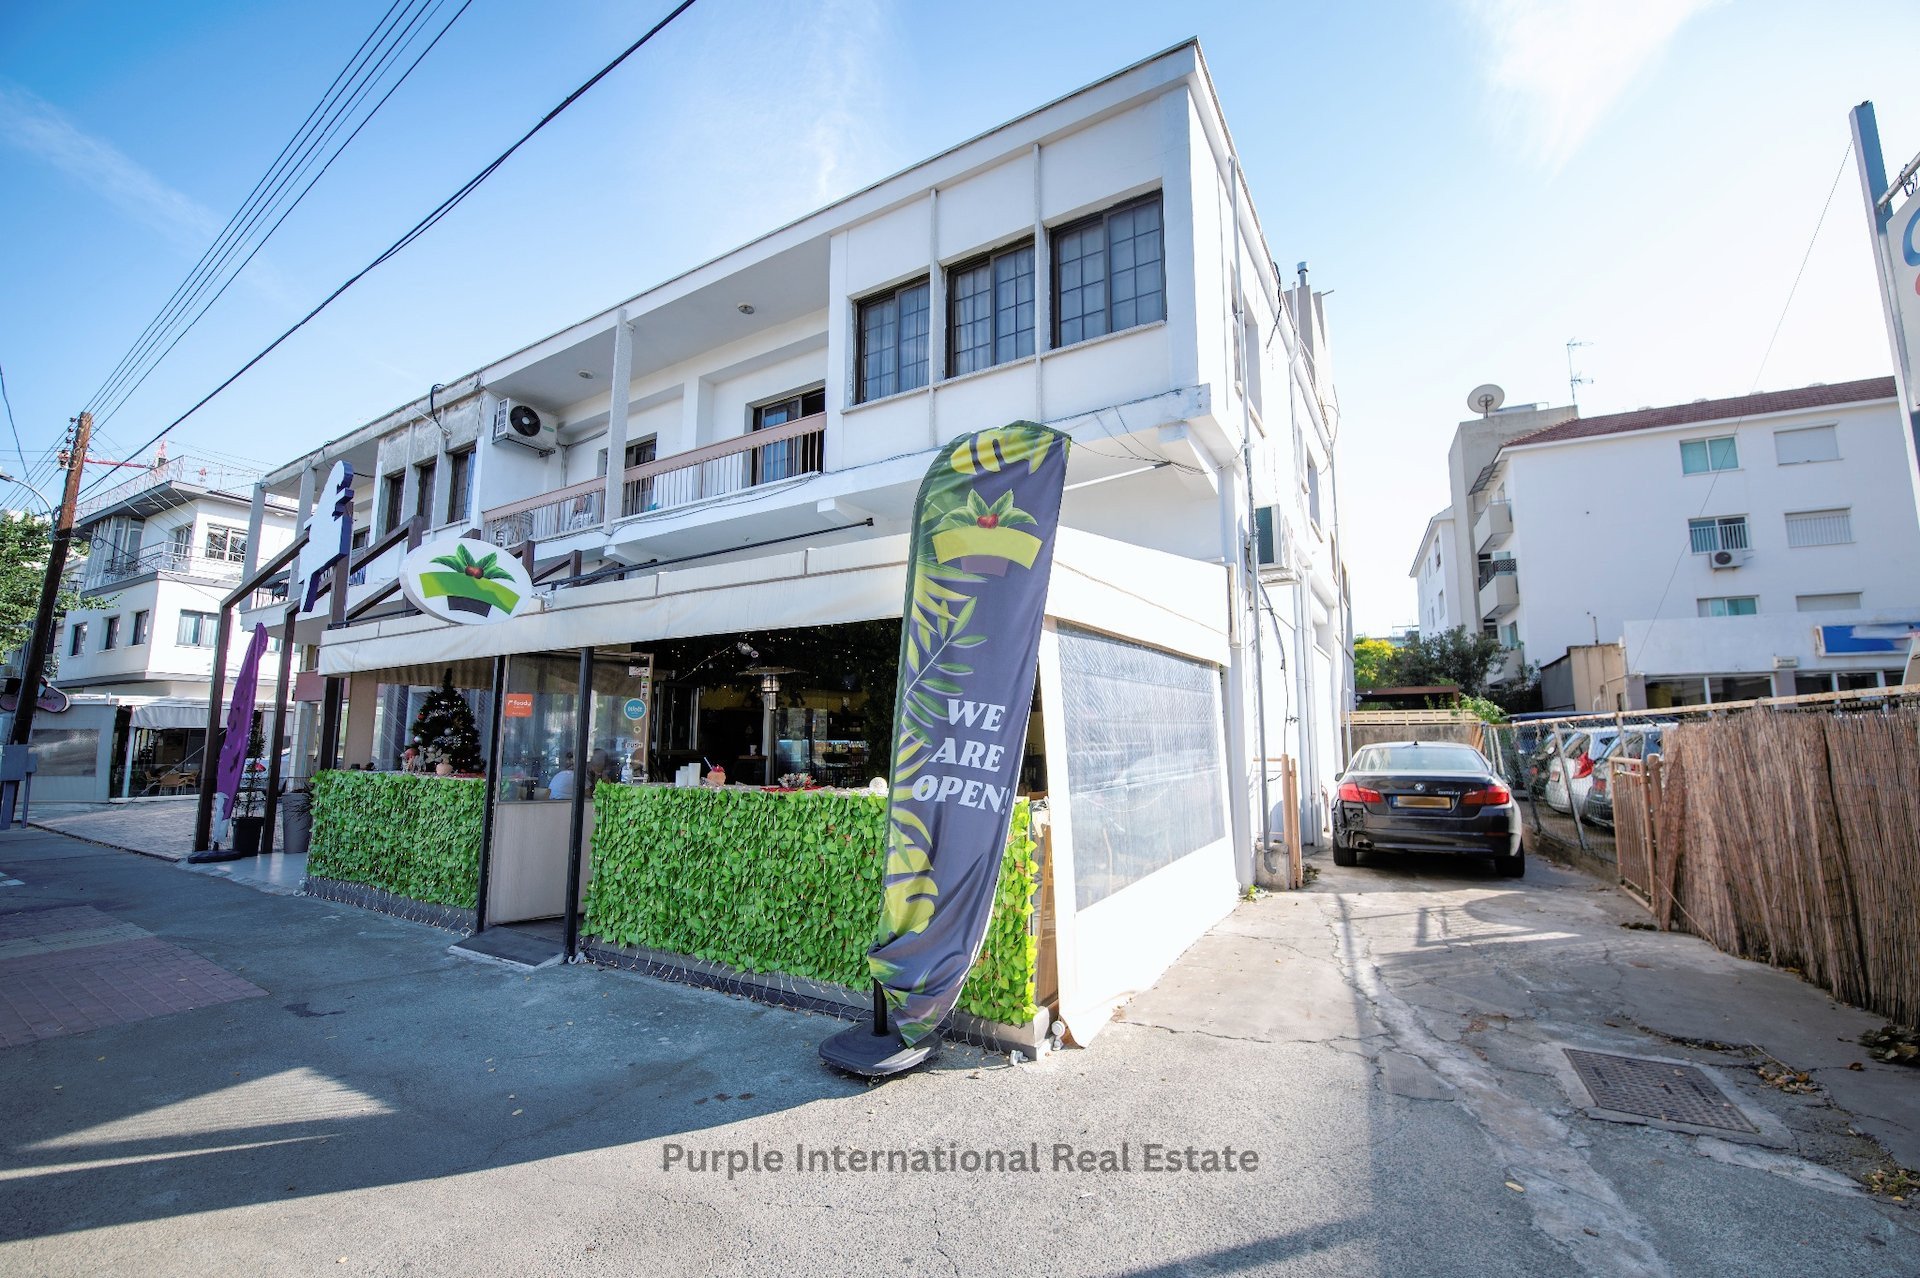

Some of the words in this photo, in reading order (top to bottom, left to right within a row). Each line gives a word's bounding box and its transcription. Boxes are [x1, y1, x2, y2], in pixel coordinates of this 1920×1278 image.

[947, 698, 1006, 731] WE
[928, 737, 1005, 772] ARE
[911, 774, 1011, 815] OPEN!
